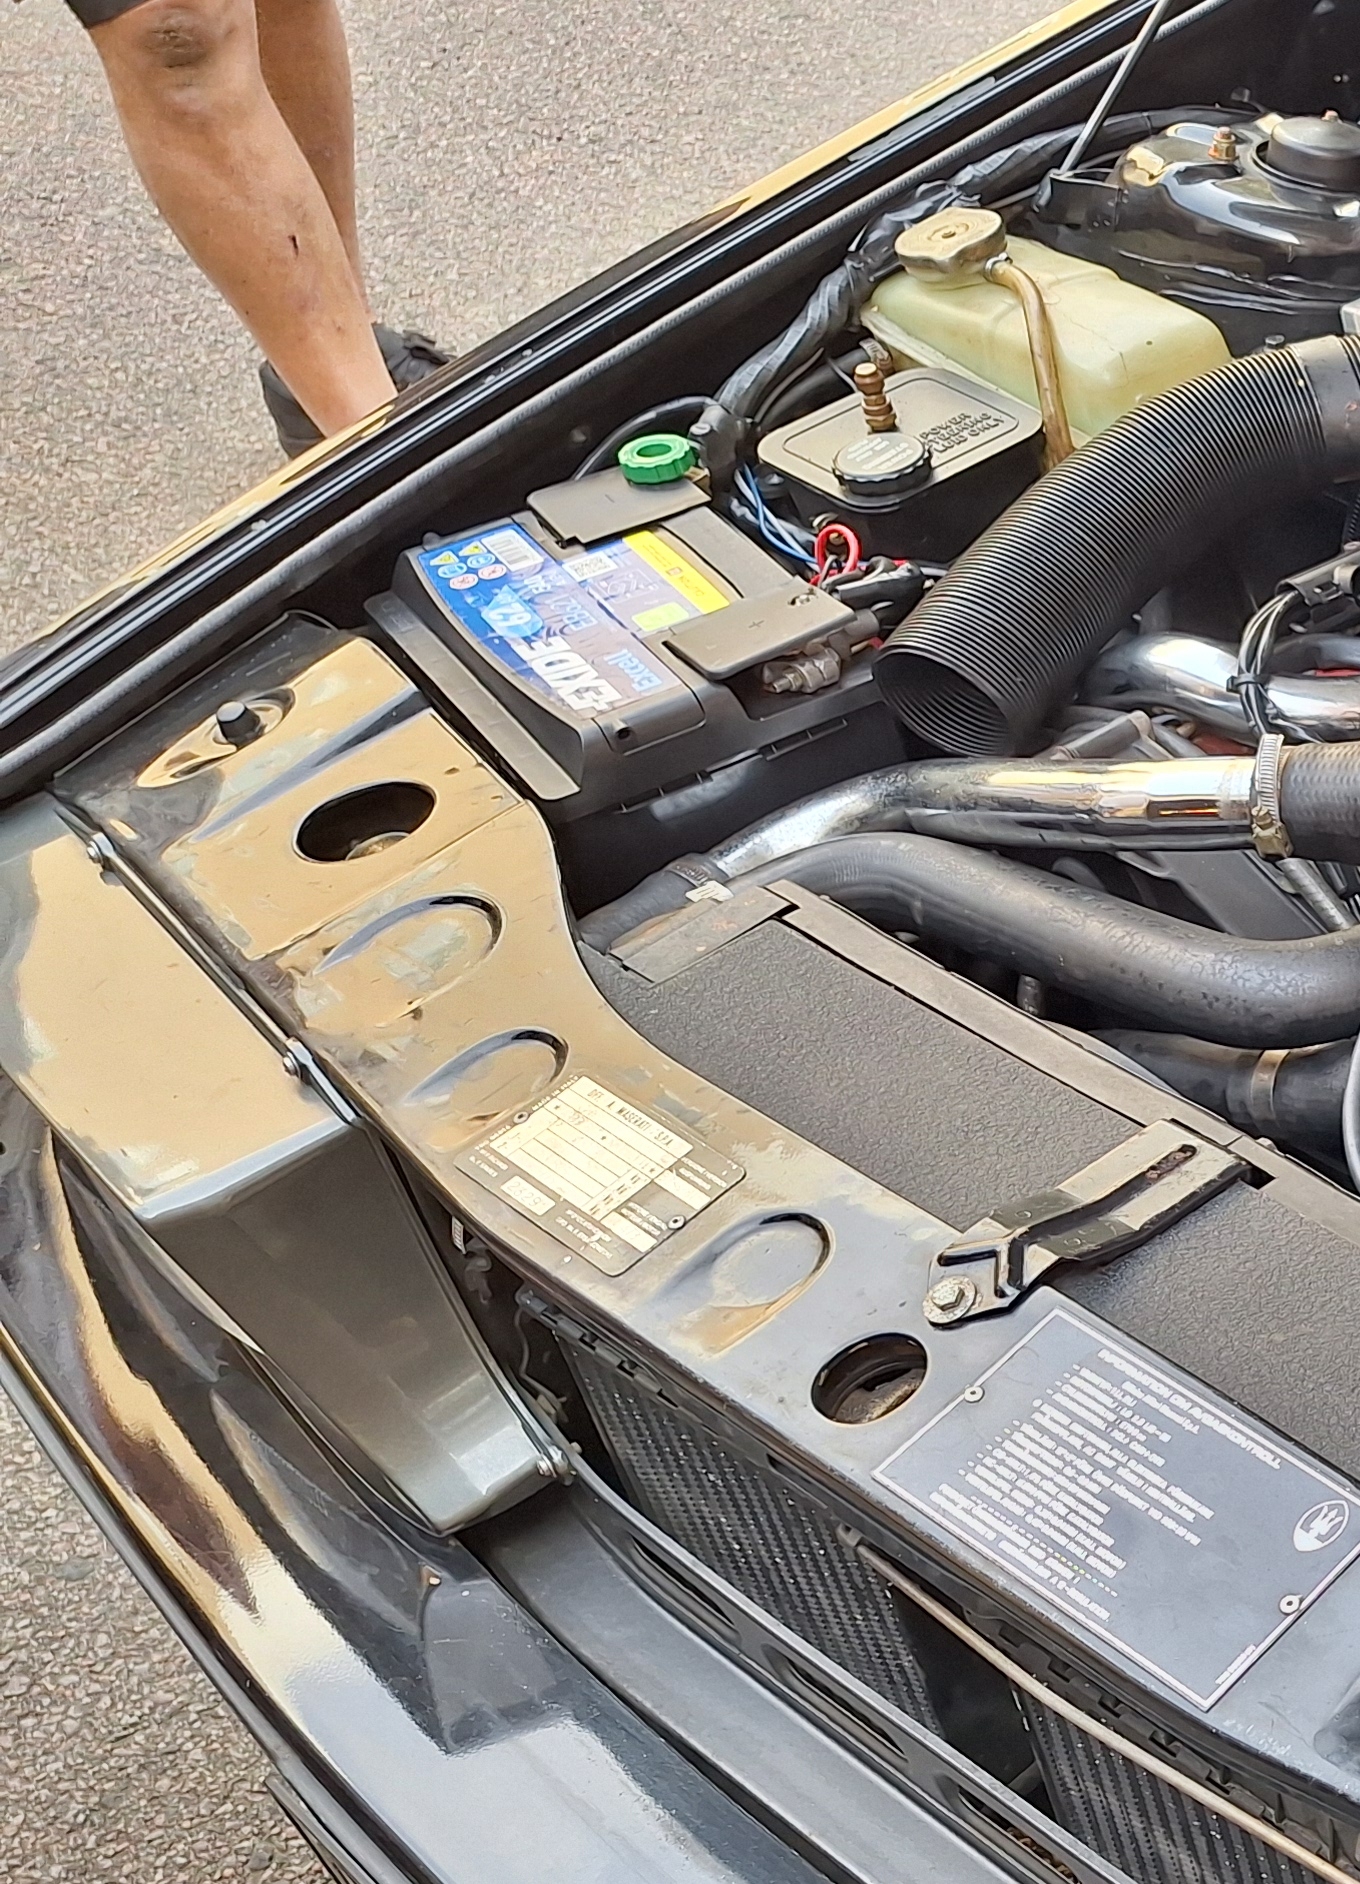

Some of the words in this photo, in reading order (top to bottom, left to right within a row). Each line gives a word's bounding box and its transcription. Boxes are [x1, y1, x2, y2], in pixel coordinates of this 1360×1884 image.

[919, 412, 972, 438] POWER
[927, 413, 993, 447] TEERING
[487, 602, 533, 629] 62
[548, 595, 600, 632] EB621
[513, 635, 623, 713] EXIDE
[603, 647, 664, 693] Excell
[617, 1107, 650, 1132] MASERATI
[1098, 1348, 1170, 1399] INFORMATION
